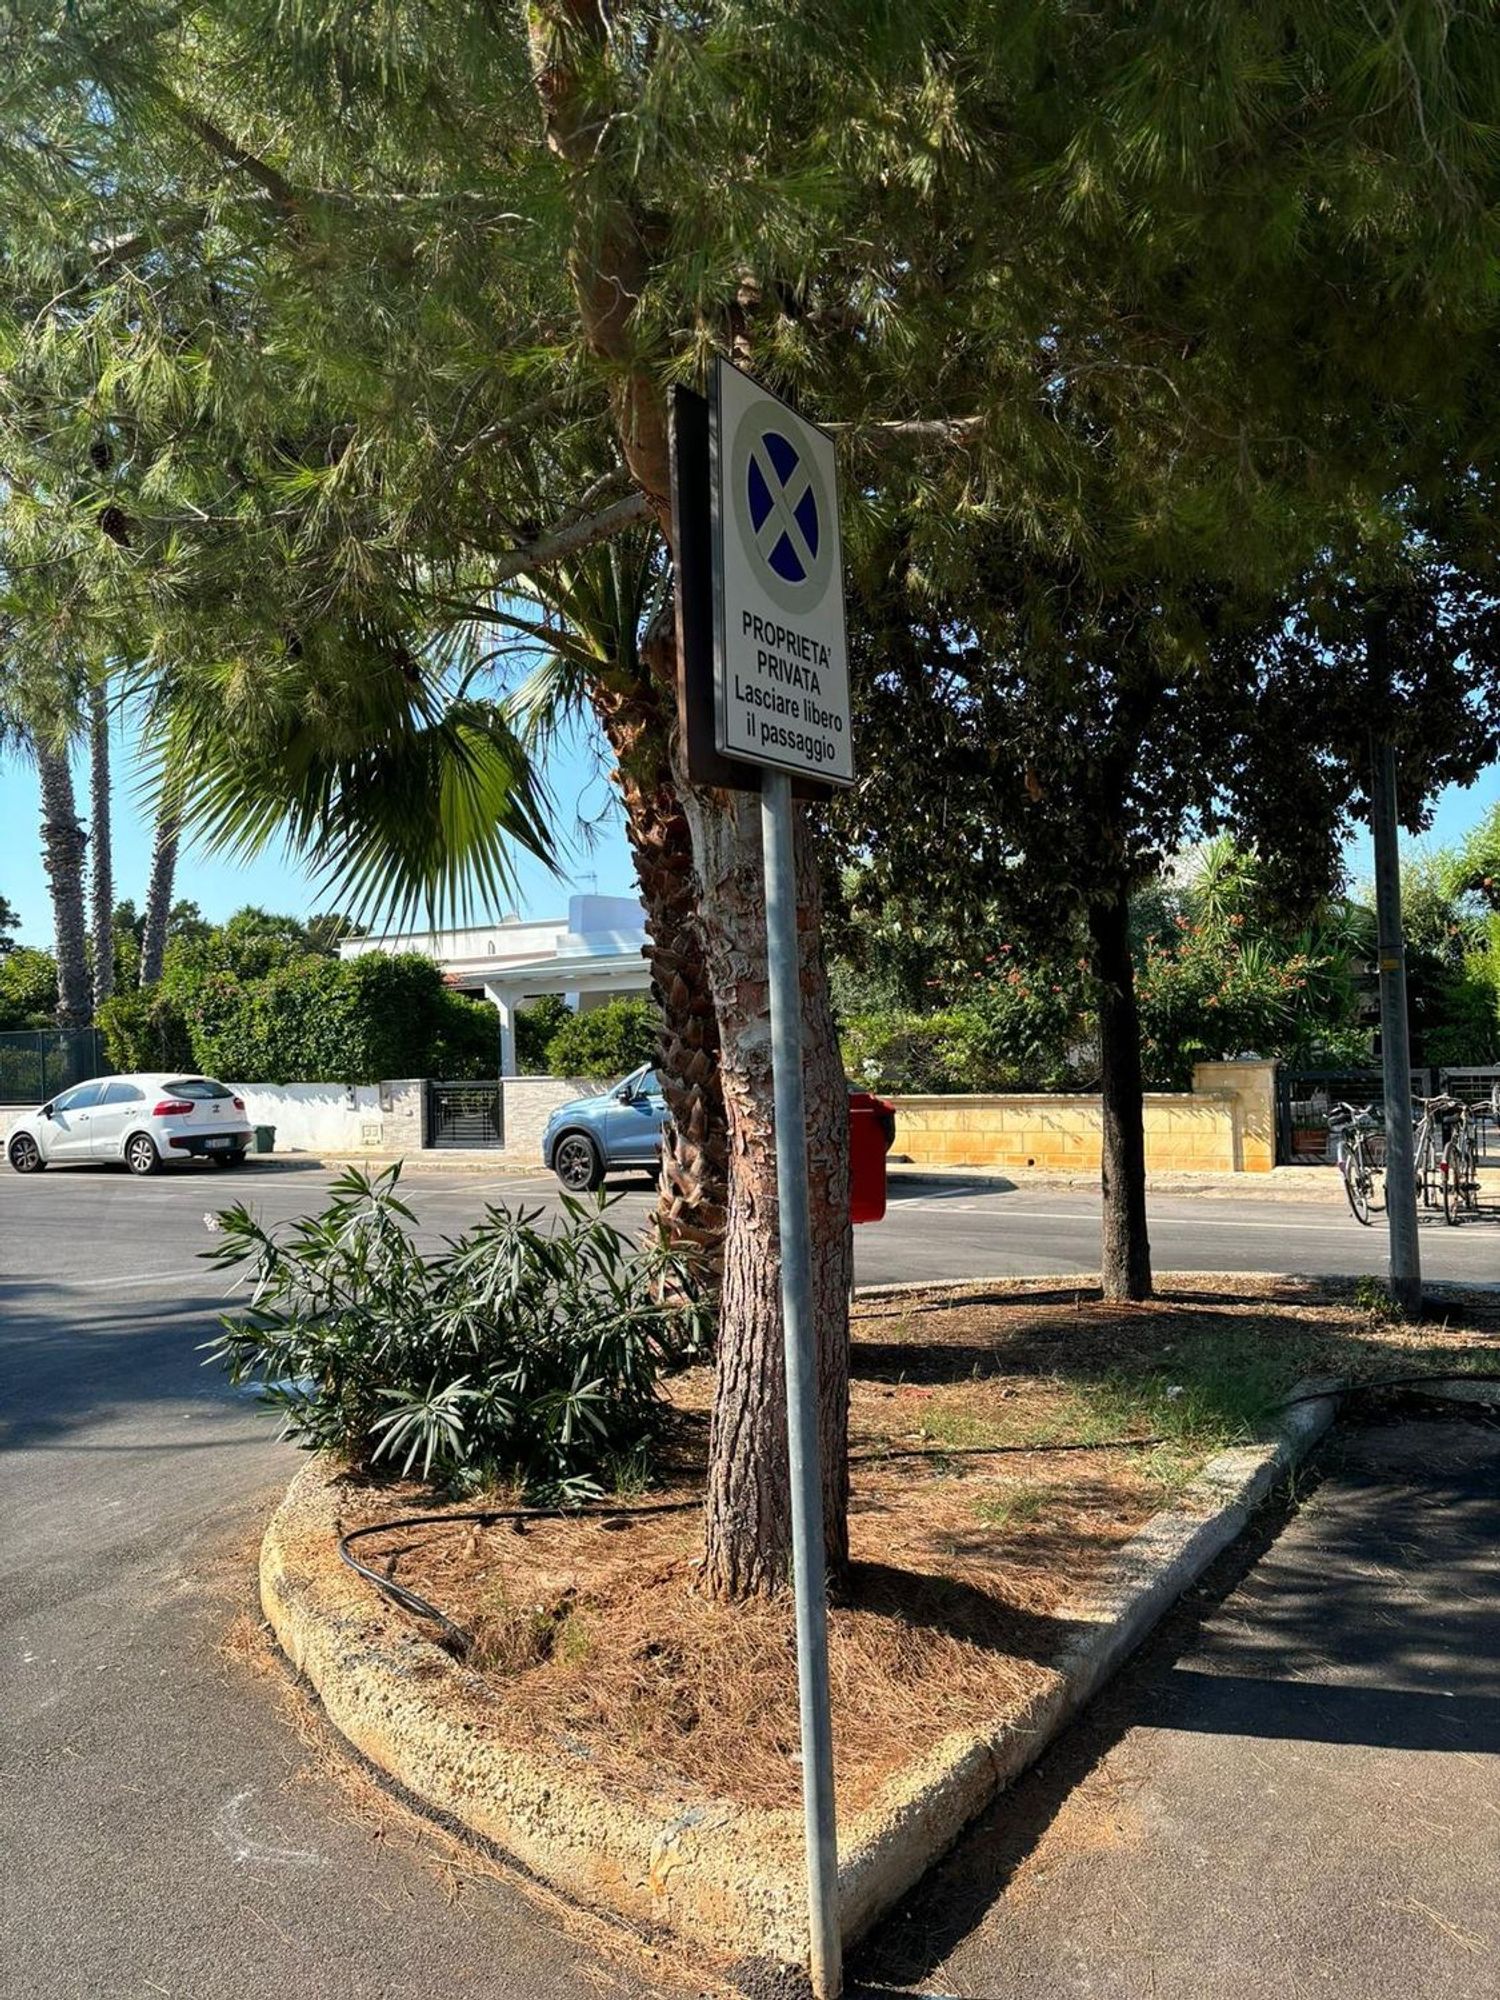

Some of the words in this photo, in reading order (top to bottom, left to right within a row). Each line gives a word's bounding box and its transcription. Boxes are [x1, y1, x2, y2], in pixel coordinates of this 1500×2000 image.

[757, 650, 821, 695] PRIVATA
[735, 675, 799, 718] Lasciare
[803, 698, 842, 732] libero
[747, 712, 755, 737] il
[761, 721, 835, 762] passaggio
